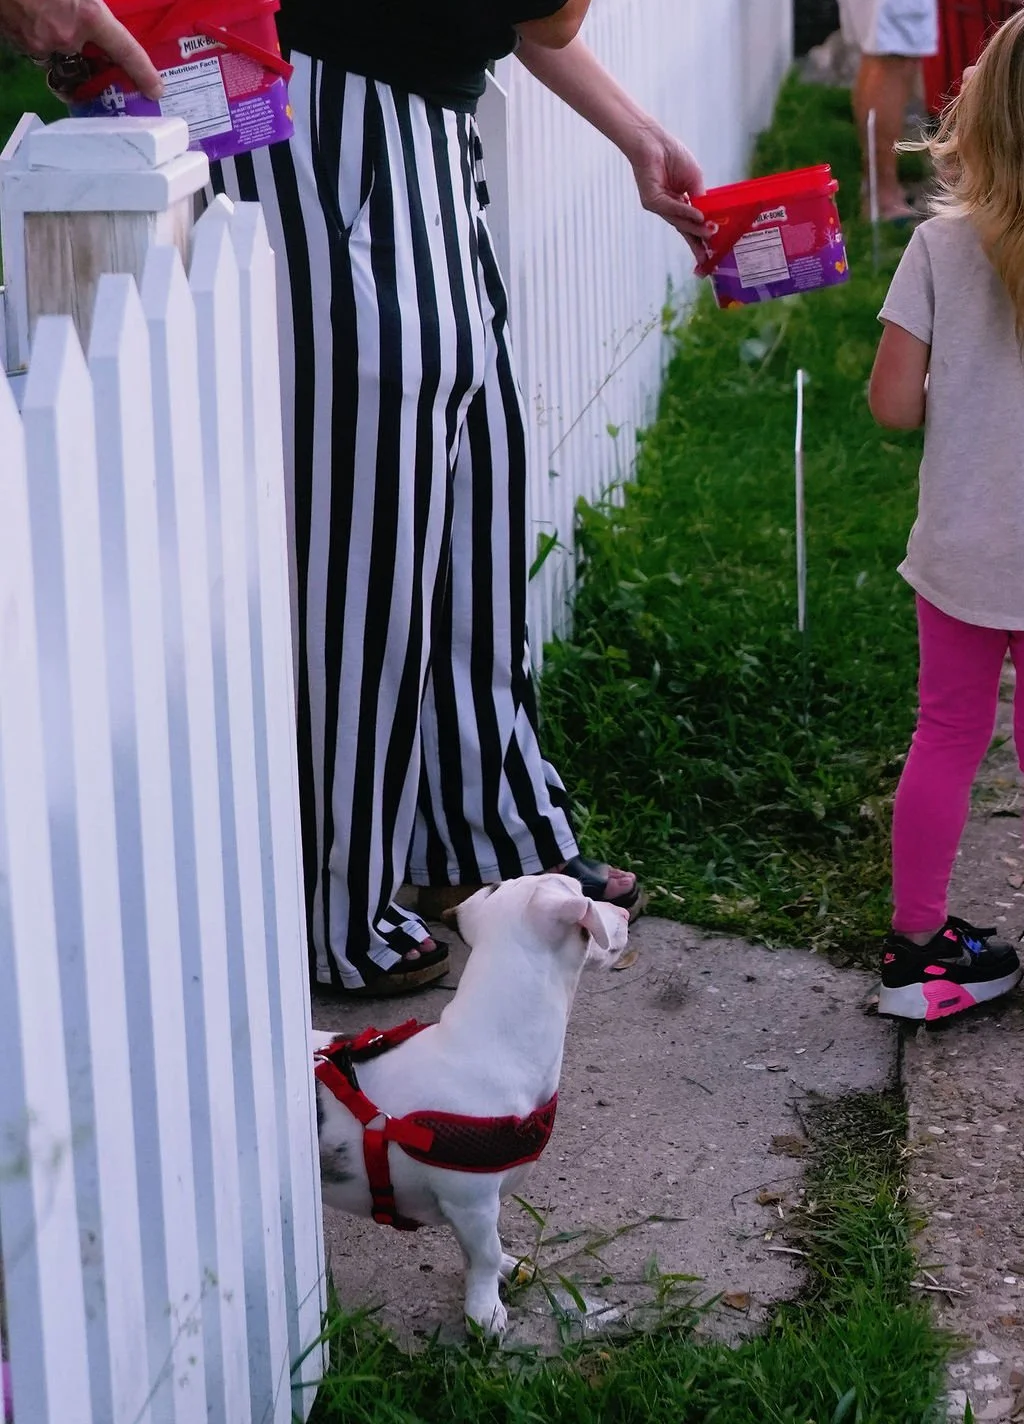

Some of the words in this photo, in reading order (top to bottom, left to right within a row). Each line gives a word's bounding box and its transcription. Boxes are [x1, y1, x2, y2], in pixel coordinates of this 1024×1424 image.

[168, 63, 199, 76] Nutrition
[199, 58, 218, 68] Facts
[754, 209, 785, 223] ILK-BONE
